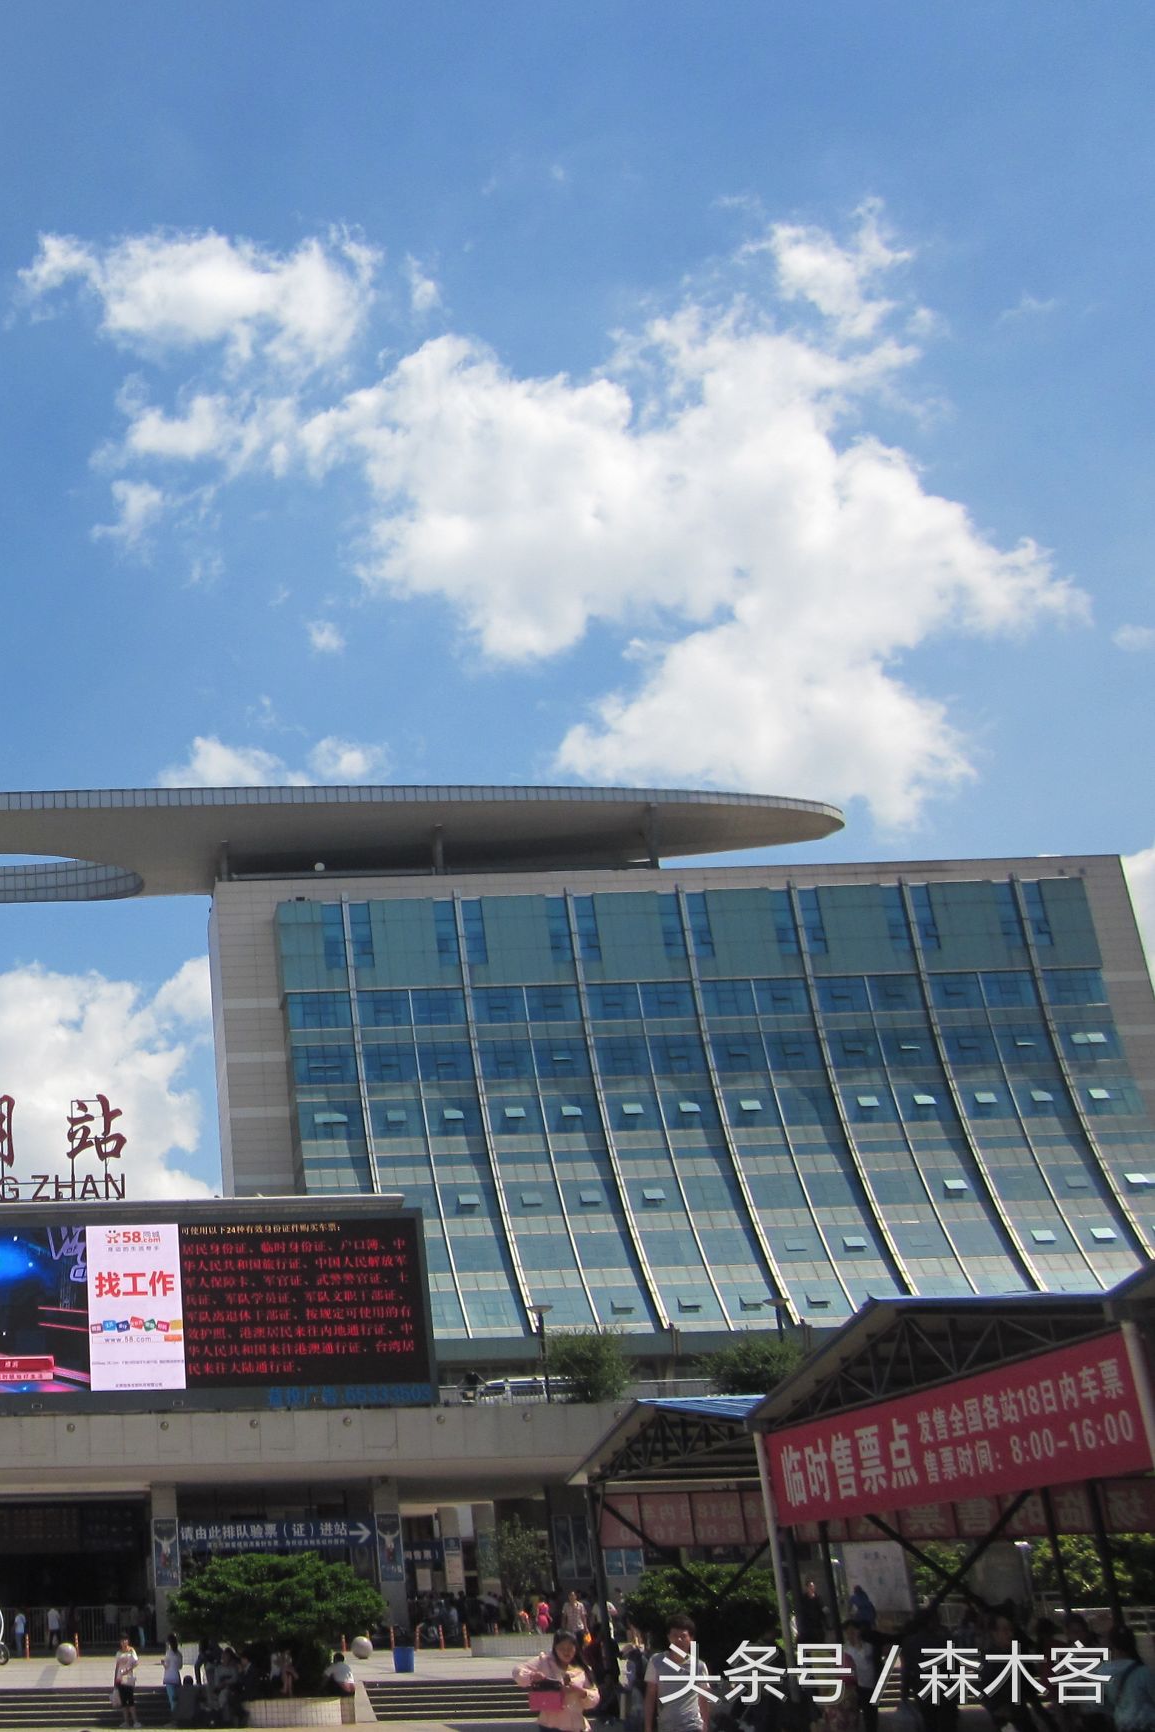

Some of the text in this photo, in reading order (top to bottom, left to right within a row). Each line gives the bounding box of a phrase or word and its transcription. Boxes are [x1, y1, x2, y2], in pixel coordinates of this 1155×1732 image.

[31, 1173, 126, 1200] ZHAN
[95, 1271, 175, 1298] 找工作
[917, 1358, 1127, 1444] 发售全国各站18日内车票
[781, 1418, 919, 1507] 临时售票点
[1010, 1409, 1135, 1465] 8:00-16:00
